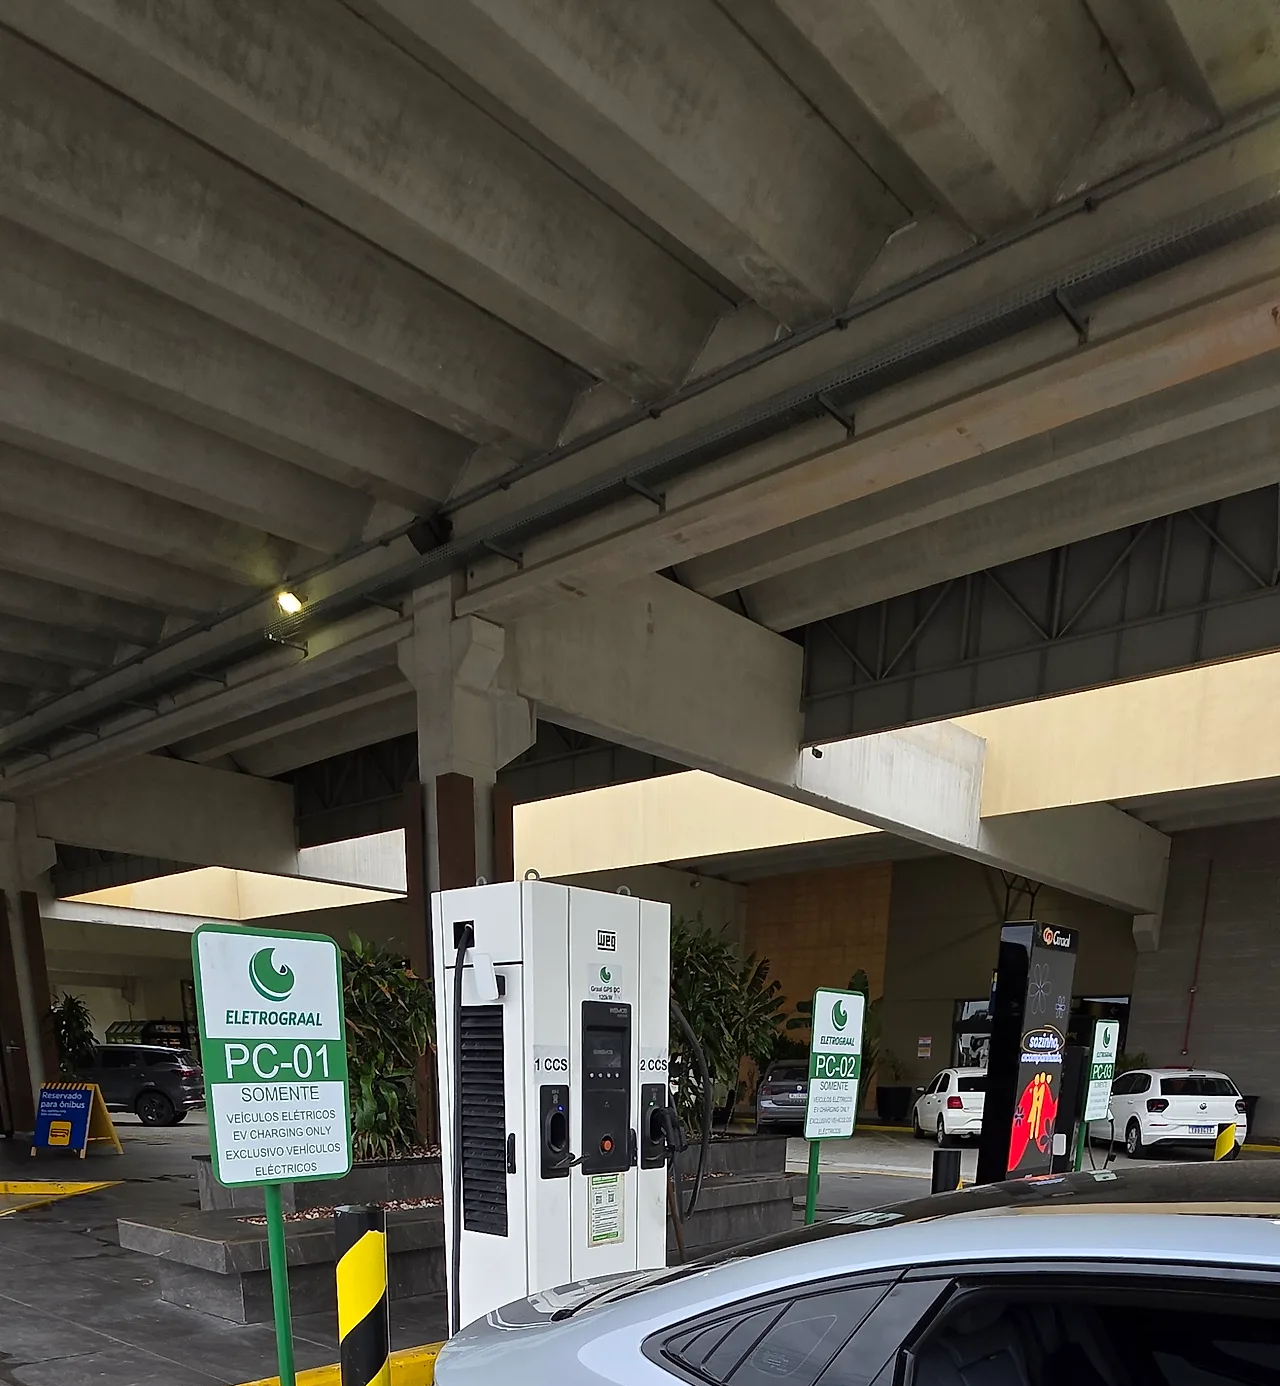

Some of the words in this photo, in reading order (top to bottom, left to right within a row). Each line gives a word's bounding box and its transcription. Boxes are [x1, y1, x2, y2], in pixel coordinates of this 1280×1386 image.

[1053, 931, 1070, 947] Graal
[226, 1010, 322, 1026] ELETROGRAAL
[224, 1043, 329, 1080] PC-01
[535, 1059, 540, 1070] 1
[544, 1058, 568, 1071] CCS
[640, 1060, 645, 1070] 2
[648, 1060, 667, 1071] CCS
[816, 1055, 856, 1078] PC-02
[1092, 1064, 1112, 1079] PC-03
[241, 1086, 320, 1102] SOMENTE
[820, 1081, 849, 1091] SOMENTE
[42, 1092, 82, 1100] Reservado
[226, 1111, 279, 1124] VEÍCULOS
[282, 1108, 336, 1121] ELÉTRICOS
[233, 1131, 248, 1141] EV
[250, 1128, 303, 1140] CHARGING
[306, 1125, 331, 1136] ONLY
[226, 1146, 284, 1160] EXCLUSIVO
[287, 1143, 340, 1156] VEHÍCULOS
[255, 1161, 317, 1176] ELÉCTRICOS
